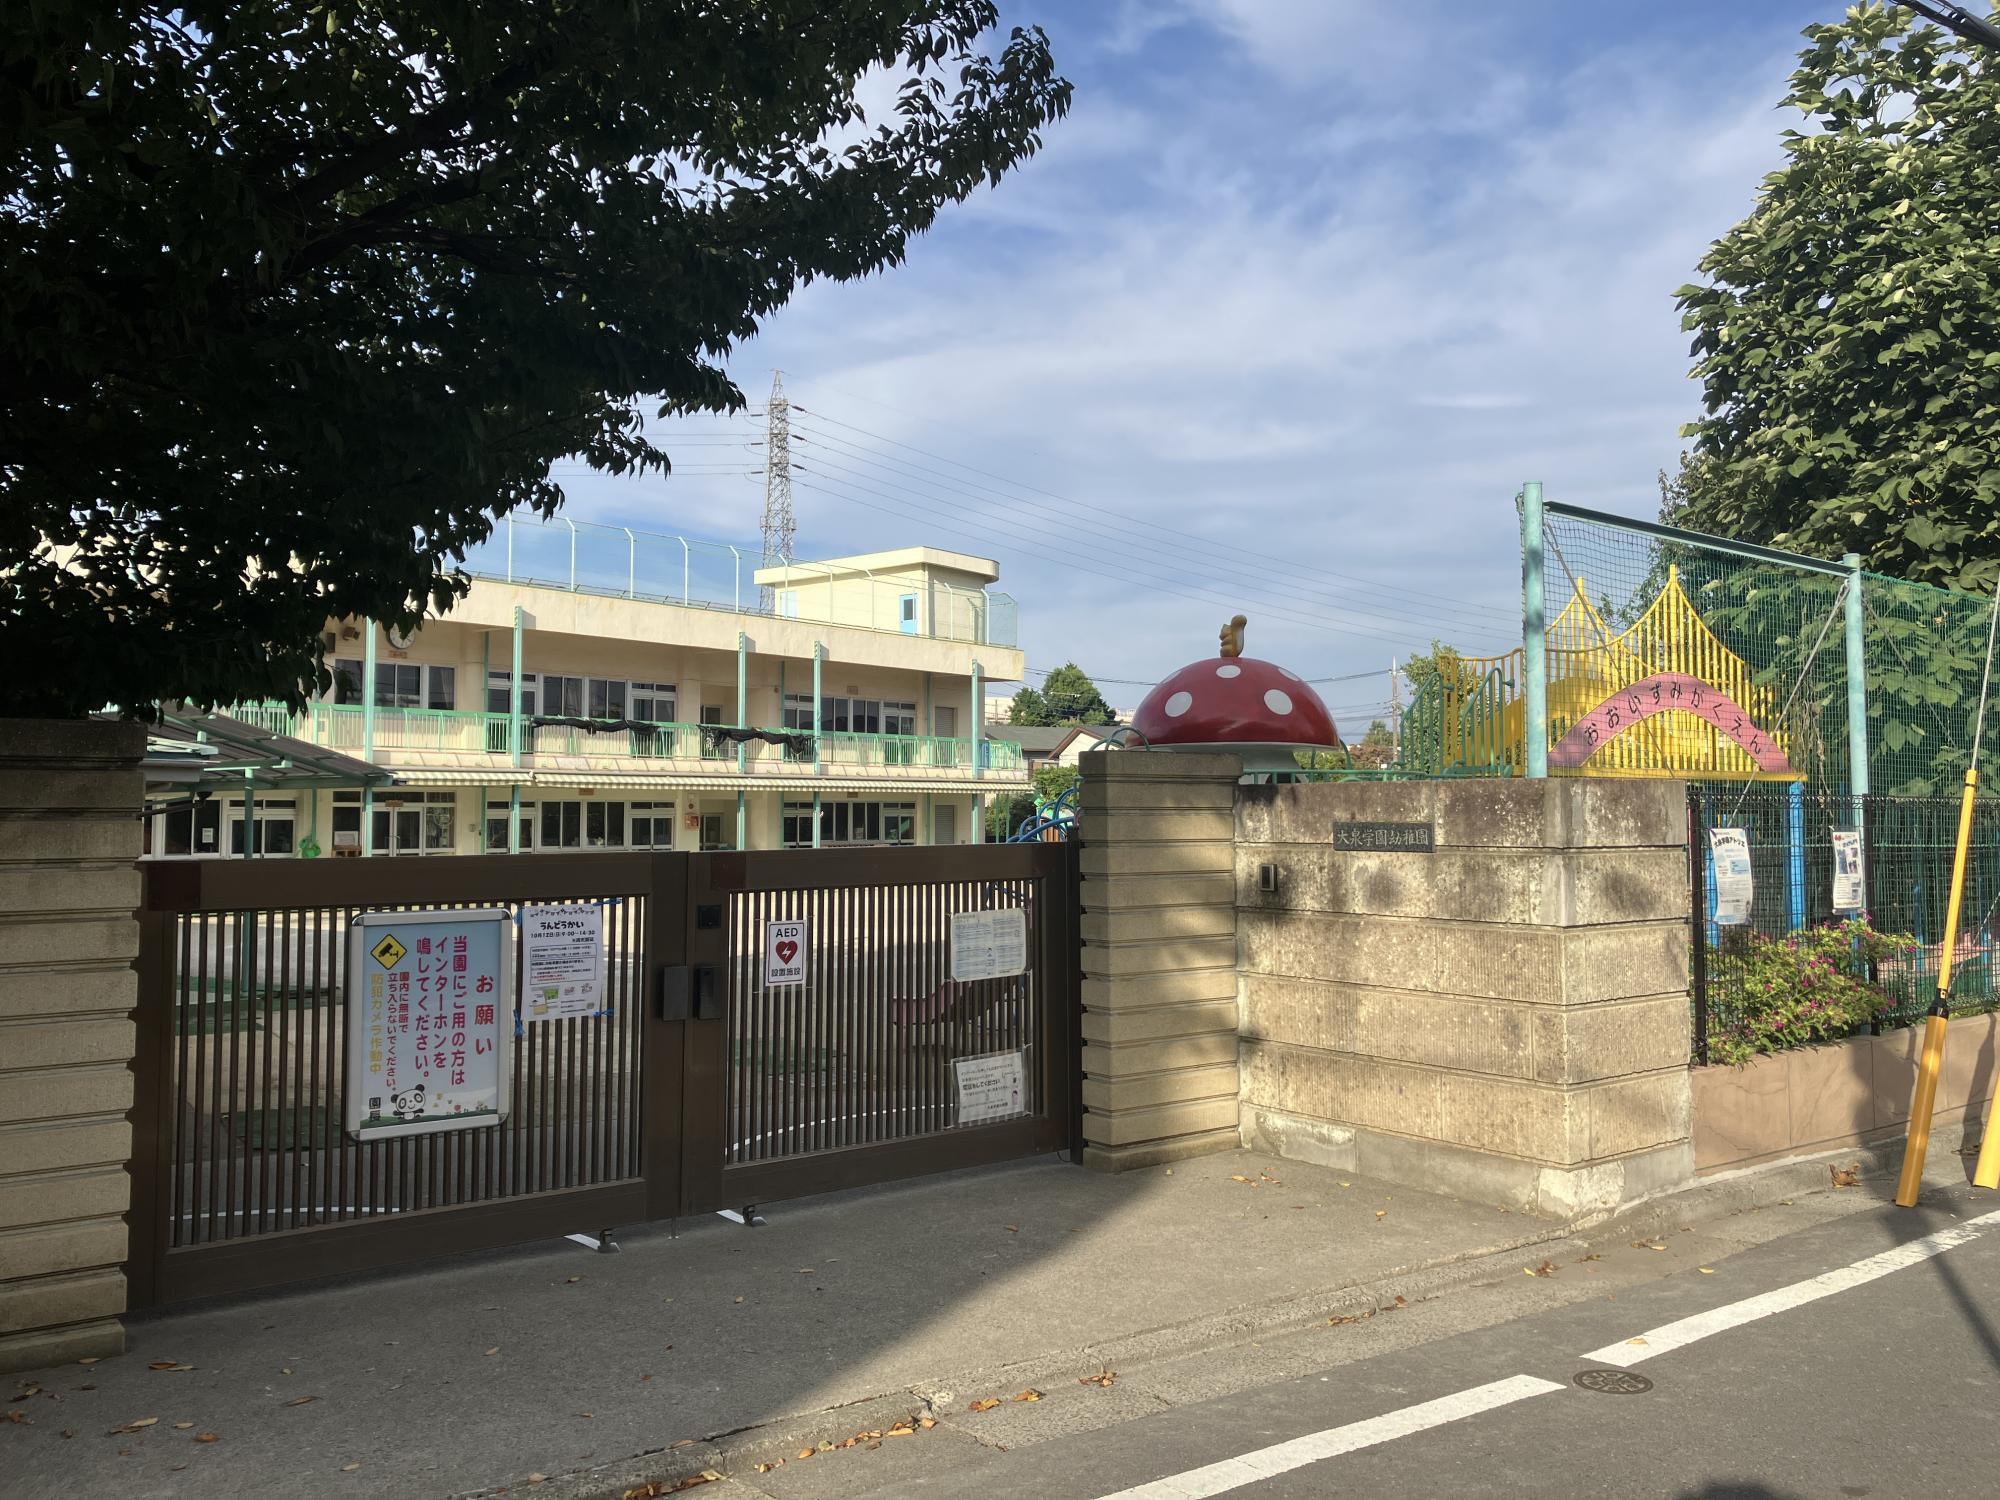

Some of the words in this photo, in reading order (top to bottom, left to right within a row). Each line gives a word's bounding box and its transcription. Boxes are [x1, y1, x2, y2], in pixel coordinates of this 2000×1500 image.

[1584, 681, 1761, 755] おおいずみがくえん
[1337, 828, 1429, 847] 大泉学園幼稚園
[540, 920, 585, 931] うんどうかい
[775, 927, 799, 938] AED
[398, 971, 410, 1033] 園内に無断で
[414, 936, 432, 1079] 鳴してください。
[432, 936, 449, 1069] インターホンを
[450, 934, 468, 1086] 当園にご用の方は
[771, 966, 801, 977] 設置施設
[369, 971, 384, 1075] 防犯カメラ作動中
[386, 972, 399, 1092] 立ち入らないでください。
[474, 974, 495, 1056] お願い
